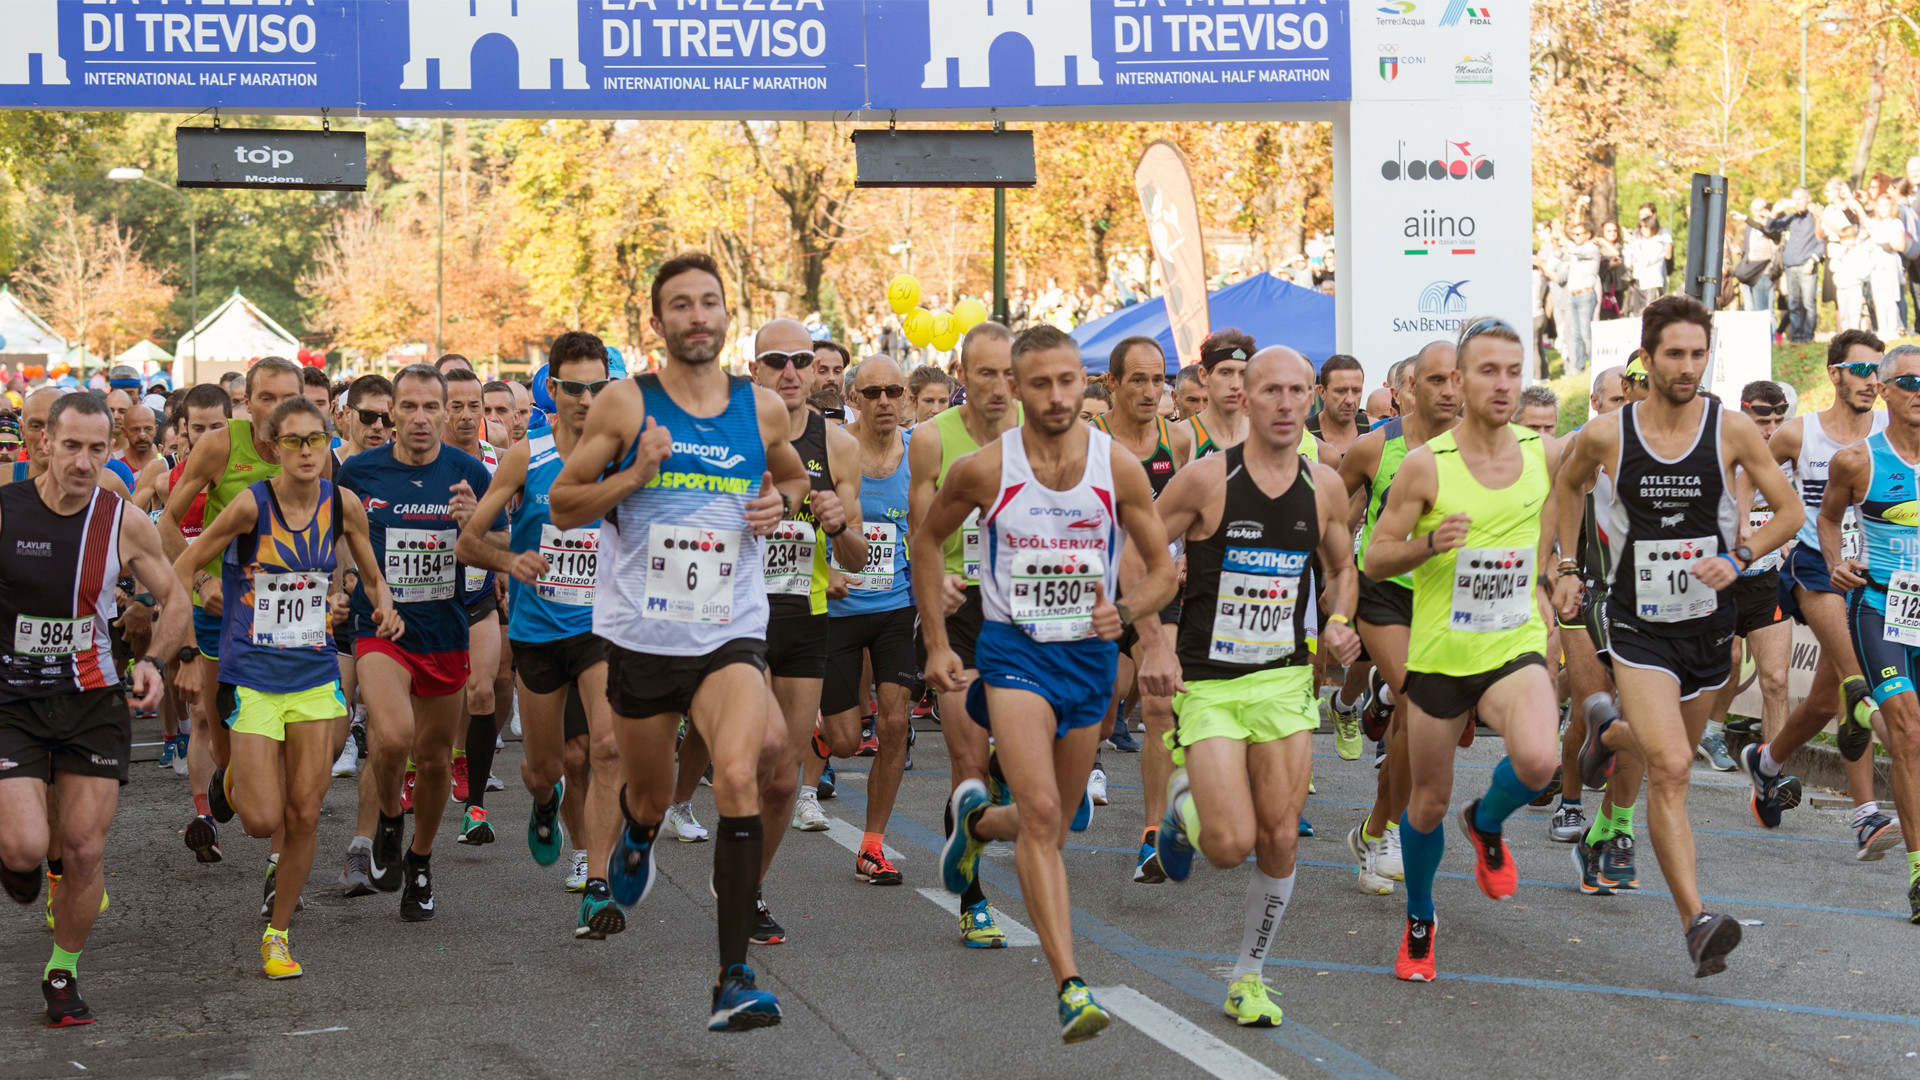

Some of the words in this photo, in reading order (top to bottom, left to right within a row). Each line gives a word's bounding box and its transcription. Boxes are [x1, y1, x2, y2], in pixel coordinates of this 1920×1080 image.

[83, 13, 124, 52] DI
[135, 13, 317, 53] TREVISO
[602, 18, 642, 57] DI
[652, 18, 826, 58] TREVISO
[1114, 15, 1153, 53] DI
[1162, 12, 1329, 52] TREVISO
[1401, 56, 1426, 64] CONI
[1116, 70, 1218, 85] INTERNATIONAL
[1221, 69, 1256, 83] HALF
[1259, 68, 1330, 82] MARATHON
[1455, 65, 1493, 74] Montello
[84, 72, 196, 86] INTERNATIONAL
[199, 72, 237, 86] HALF
[240, 73, 317, 86] MARATHON
[603, 77, 710, 90] INTERNATIONAL
[714, 77, 750, 90] HALF
[753, 77, 827, 90] MARATHON
[1381, 139, 1495, 181] diadora
[245, 175, 304, 183] Modena
[1404, 209, 1475, 238] aiino
[1153, 462, 1170, 470] WHY
[662, 472, 752, 494] SPORTWAY
[1640, 475, 1702, 486] ATLETICA
[1640, 487, 1702, 498] BIOTEKNA
[393, 503, 450, 514] CARABINI
[1030, 507, 1082, 518] GIVOVA
[16, 548, 52, 557] RUNNERS
[17, 540, 52, 550] PLAYLIFE
[765, 544, 797, 567] 234
[1227, 549, 1308, 569] DECATHLON
[403, 554, 442, 576] 1154
[557, 552, 597, 577] 1109
[550, 575, 590, 585] FABRIZIO
[686, 562, 698, 590] 6
[871, 576, 893, 585] aiino
[1667, 569, 1688, 595] 10
[431, 584, 454, 594] aiino
[1033, 580, 1082, 607] 1530
[1472, 573, 1515, 600] GHENDA
[277, 598, 304, 624] F10
[702, 601, 730, 614] aiino
[1016, 606, 1082, 618] ALESSANDRO
[1238, 603, 1281, 632] 1700
[40, 622, 74, 645] 984
[302, 629, 324, 640] aiino
[30, 646, 69, 654] ANDREA
[1791, 642, 1818, 672] WA
[1249, 893, 1284, 960] kalenji
